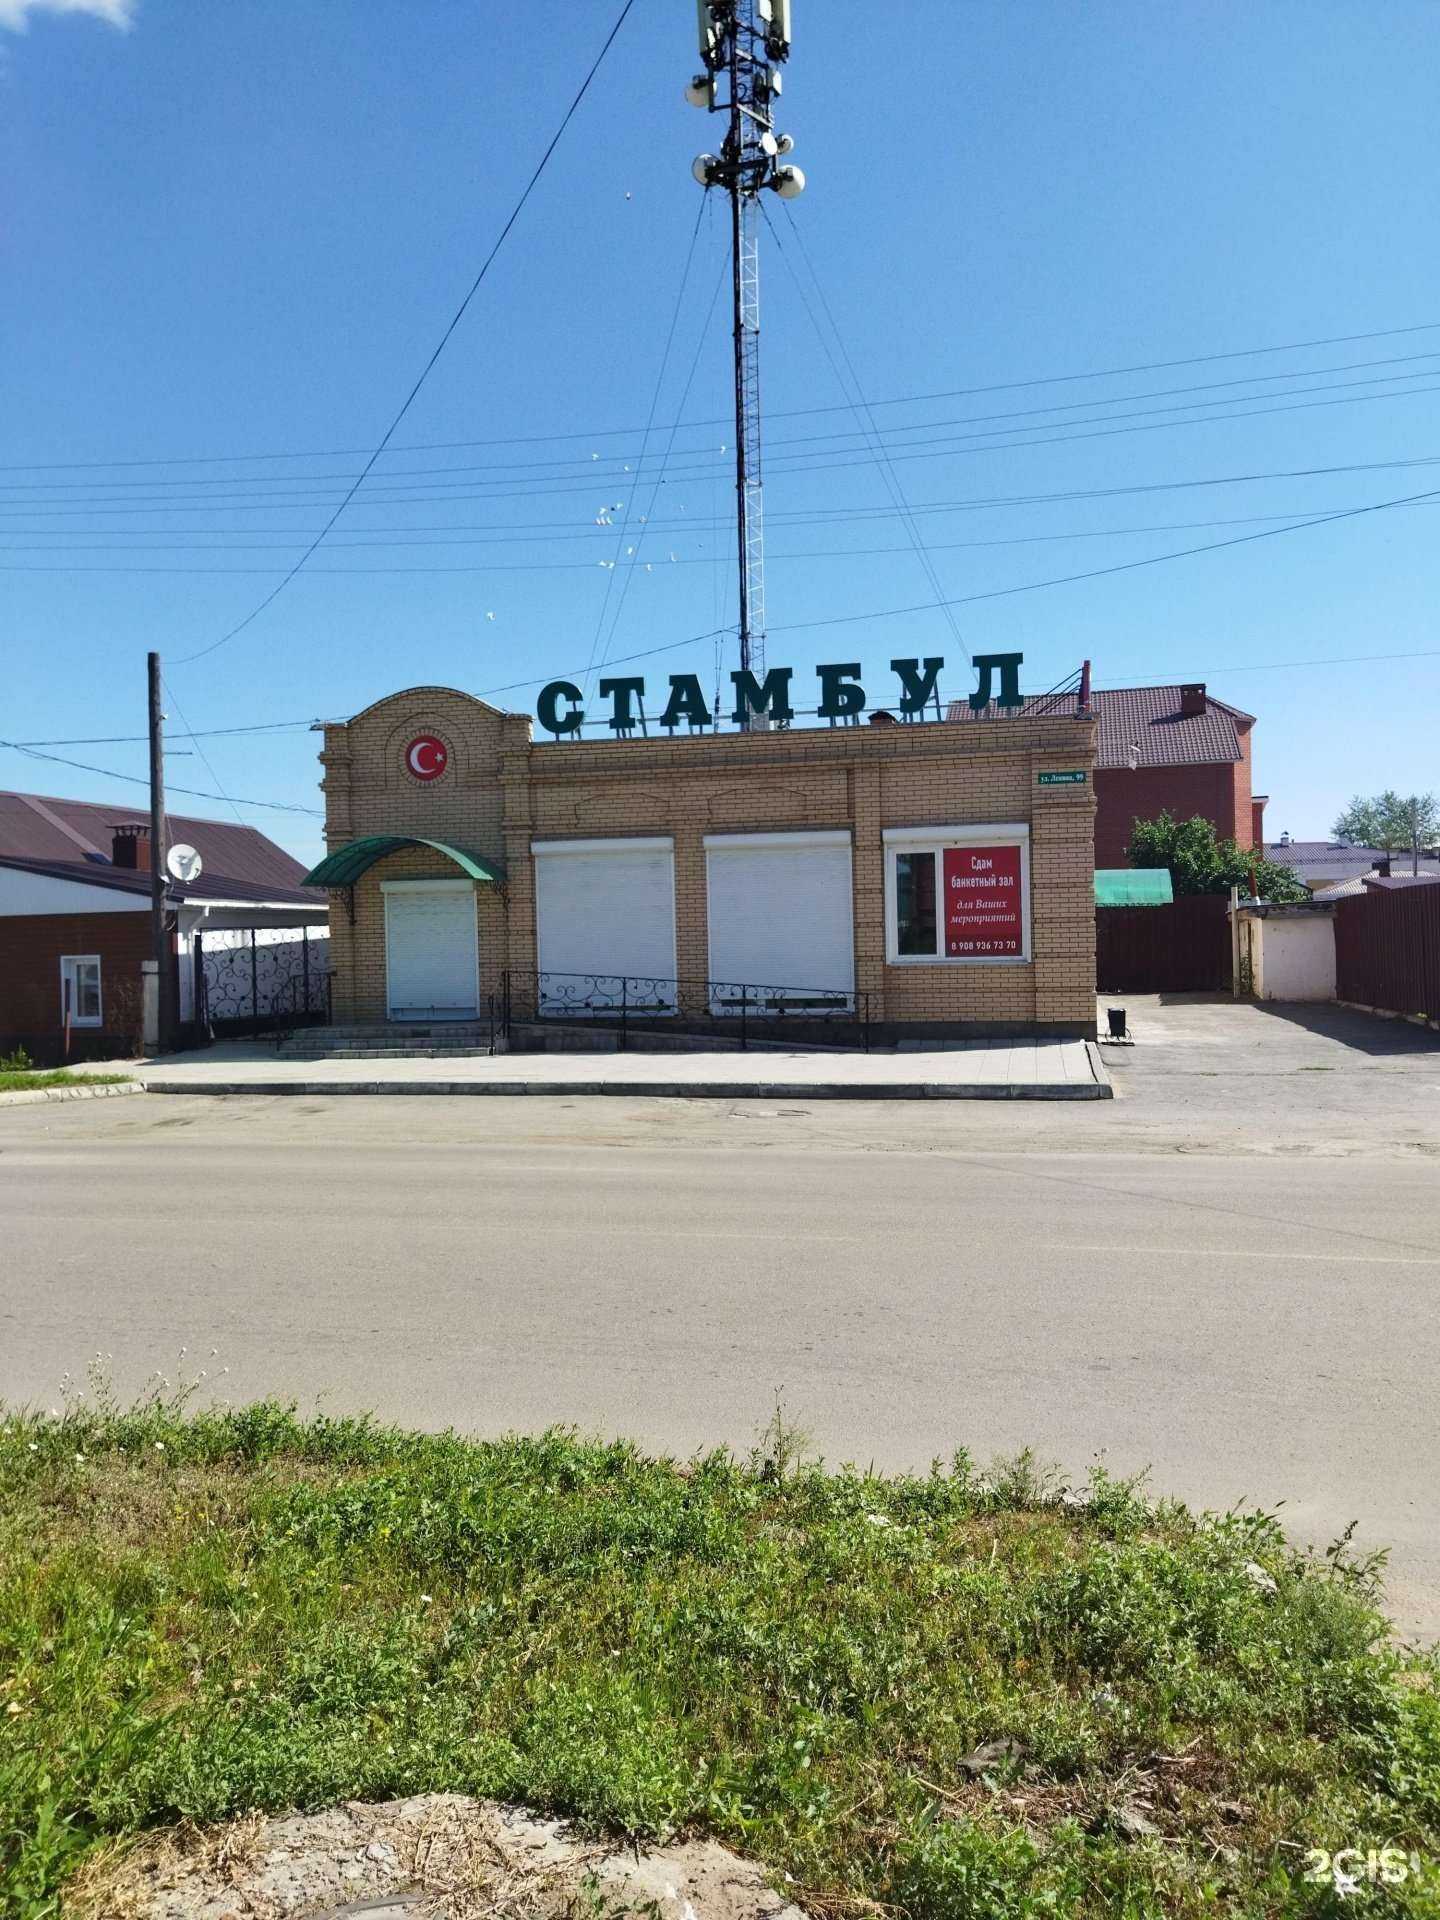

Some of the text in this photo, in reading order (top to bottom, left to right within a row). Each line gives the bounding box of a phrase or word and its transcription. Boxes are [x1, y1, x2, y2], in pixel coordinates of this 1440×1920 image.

[537, 652, 1024, 734] СТАМБУЛ
[971, 856, 993, 871] Сдам
[951, 874, 1014, 888] банкетный зал
[956, 899, 1008, 910] для Ваших
[950, 912, 1016, 926] мероприятий
[951, 940, 1017, 951] 8 908 936 73 70
